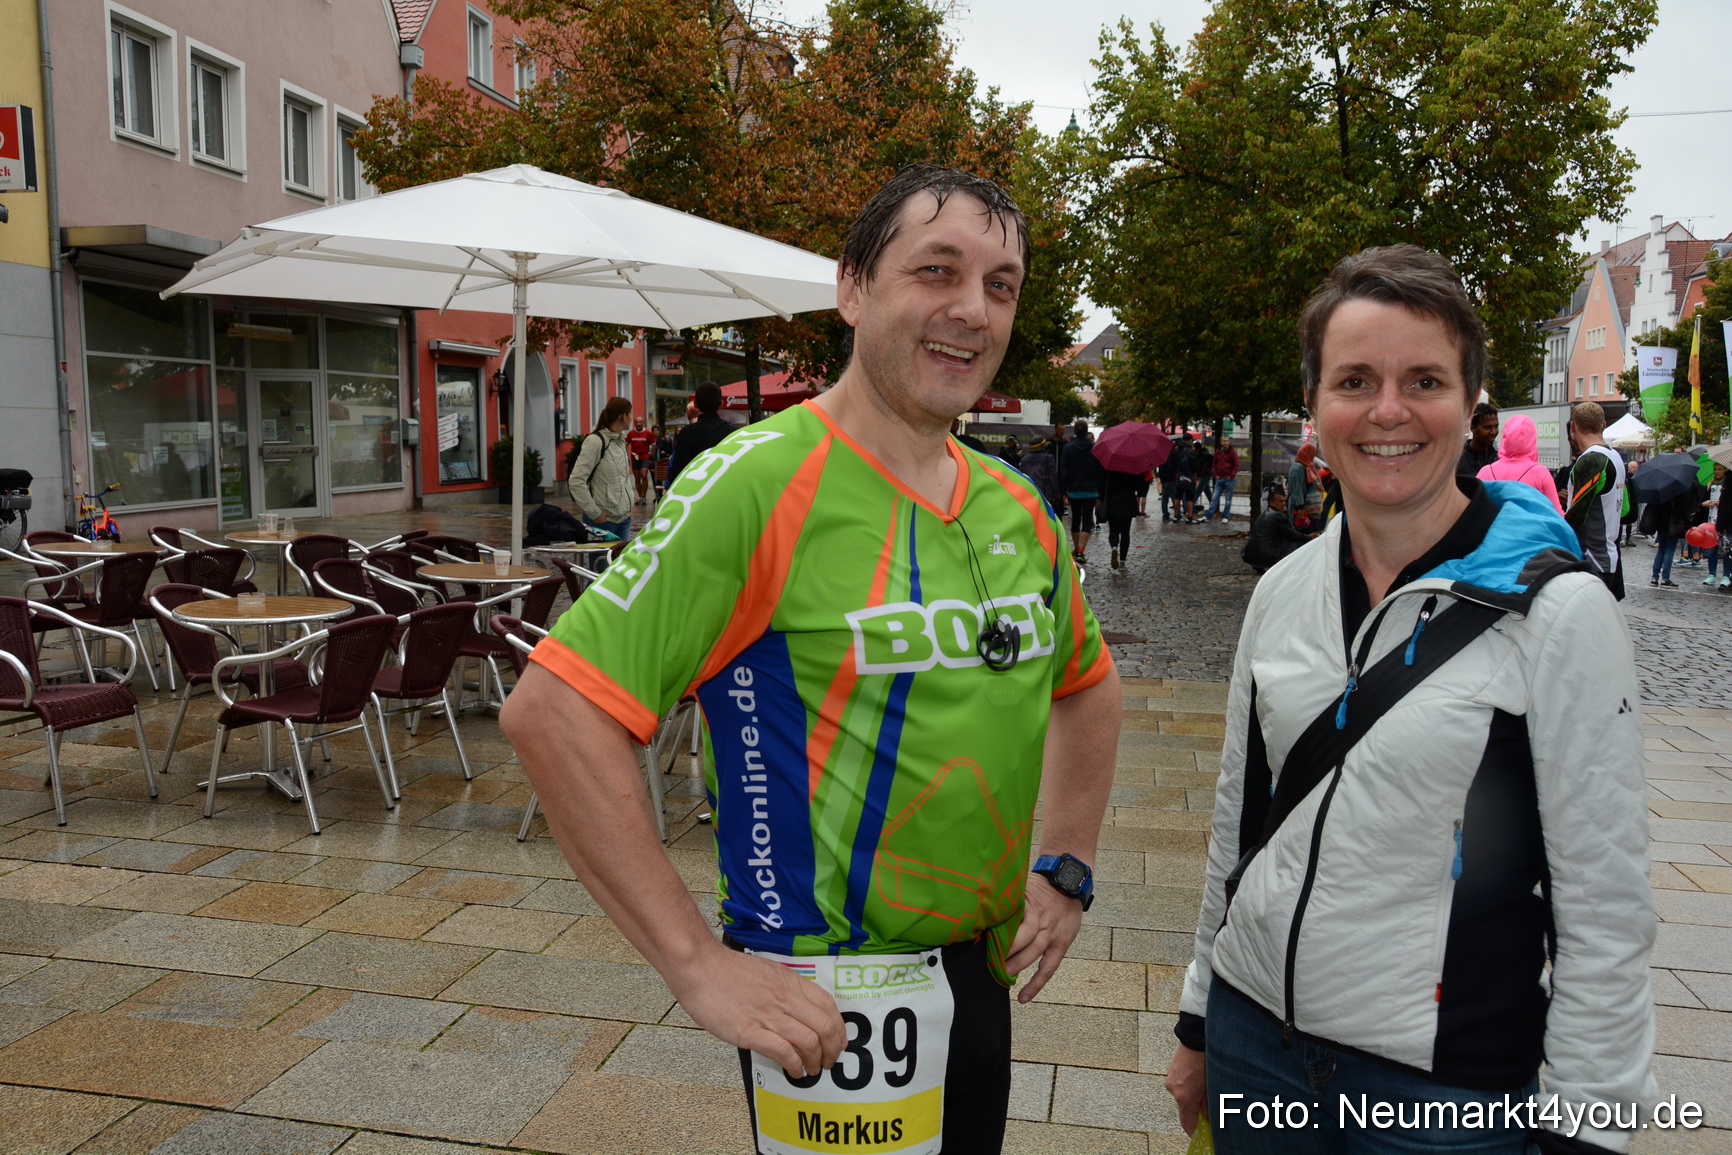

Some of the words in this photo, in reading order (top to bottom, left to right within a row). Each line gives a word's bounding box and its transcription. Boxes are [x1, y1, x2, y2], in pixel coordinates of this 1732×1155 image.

[834, 963, 932, 989] BOCK
[834, 991, 869, 1001] inspired
[872, 990, 881, 999] by
[883, 988, 904, 997] smart
[904, 983, 936, 994] concepts
[797, 1110, 904, 1146] Markus
